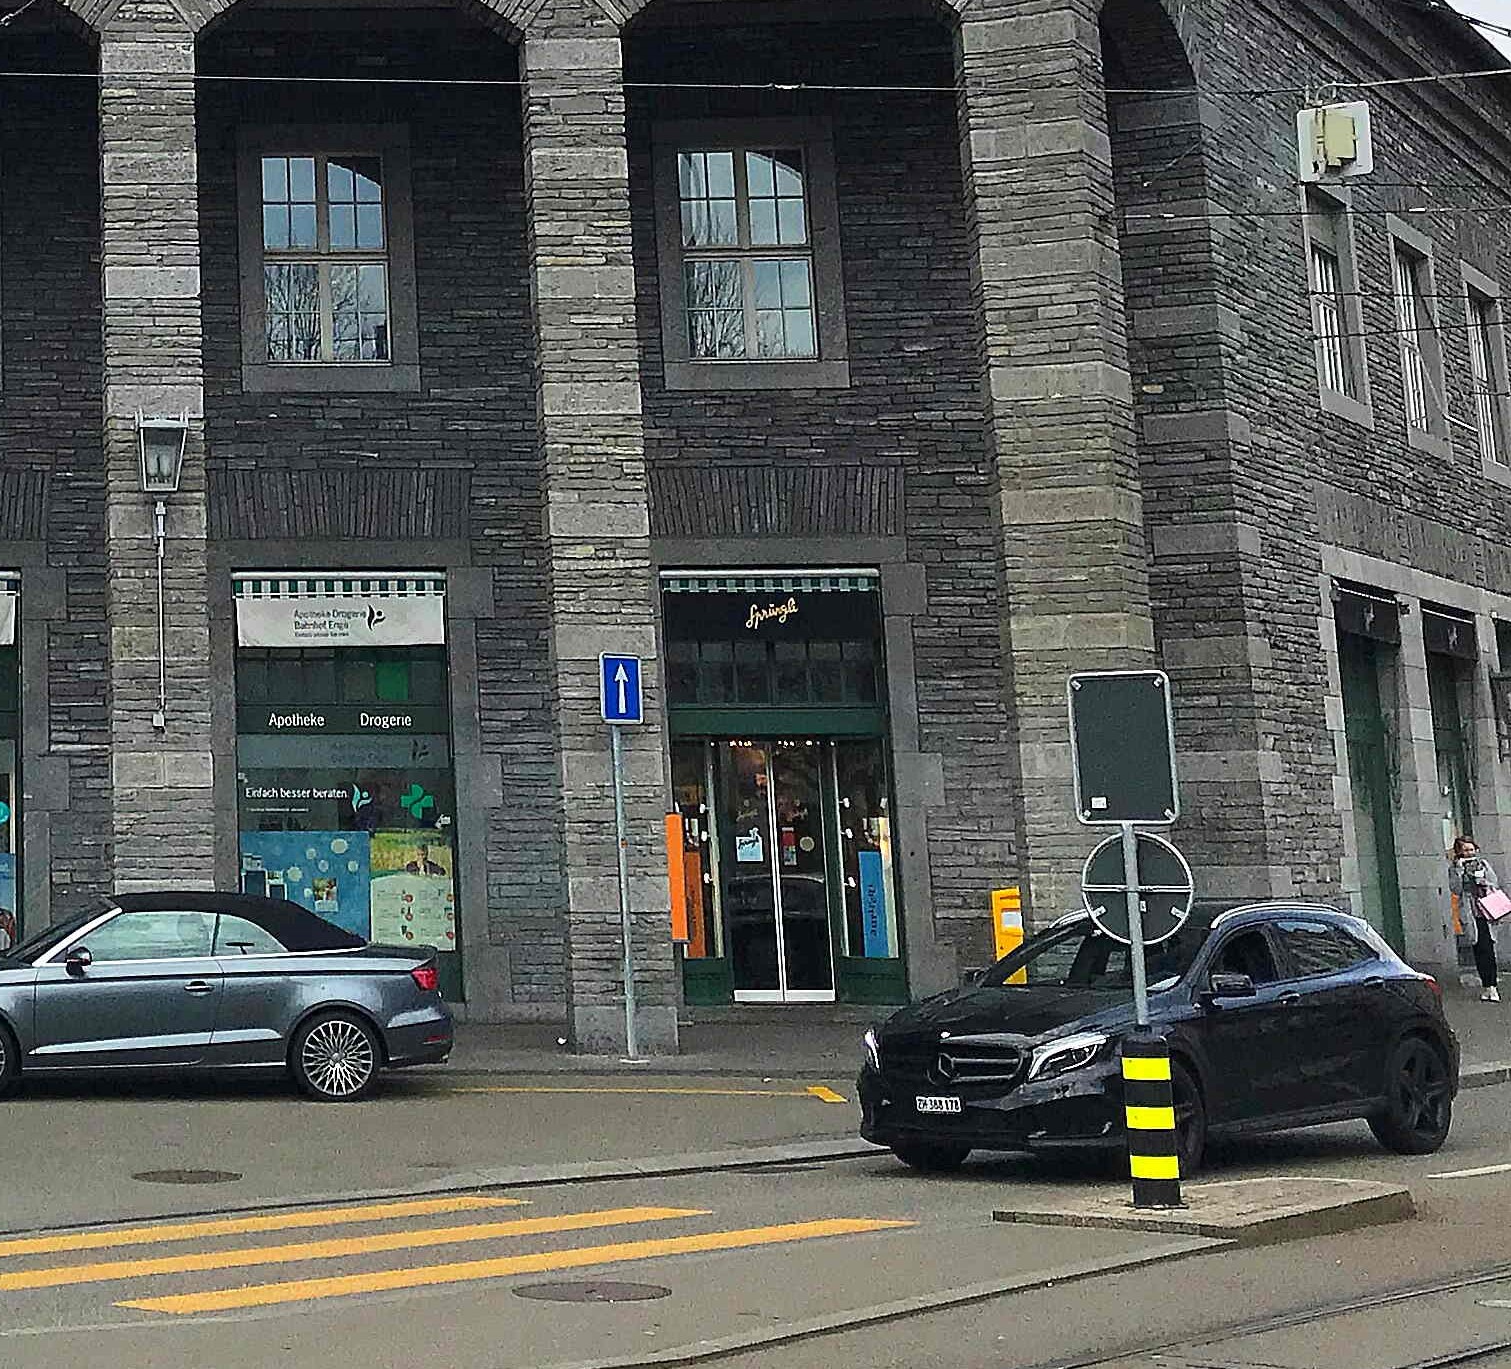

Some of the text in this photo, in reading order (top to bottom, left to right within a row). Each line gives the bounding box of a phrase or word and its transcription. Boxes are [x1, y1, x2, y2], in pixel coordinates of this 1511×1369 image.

[745, 597, 800, 629] Sprüngli
[268, 712, 413, 729] Apotheke Drogerie
[279, 787, 311, 799] besser
[312, 787, 348, 799] beraten
